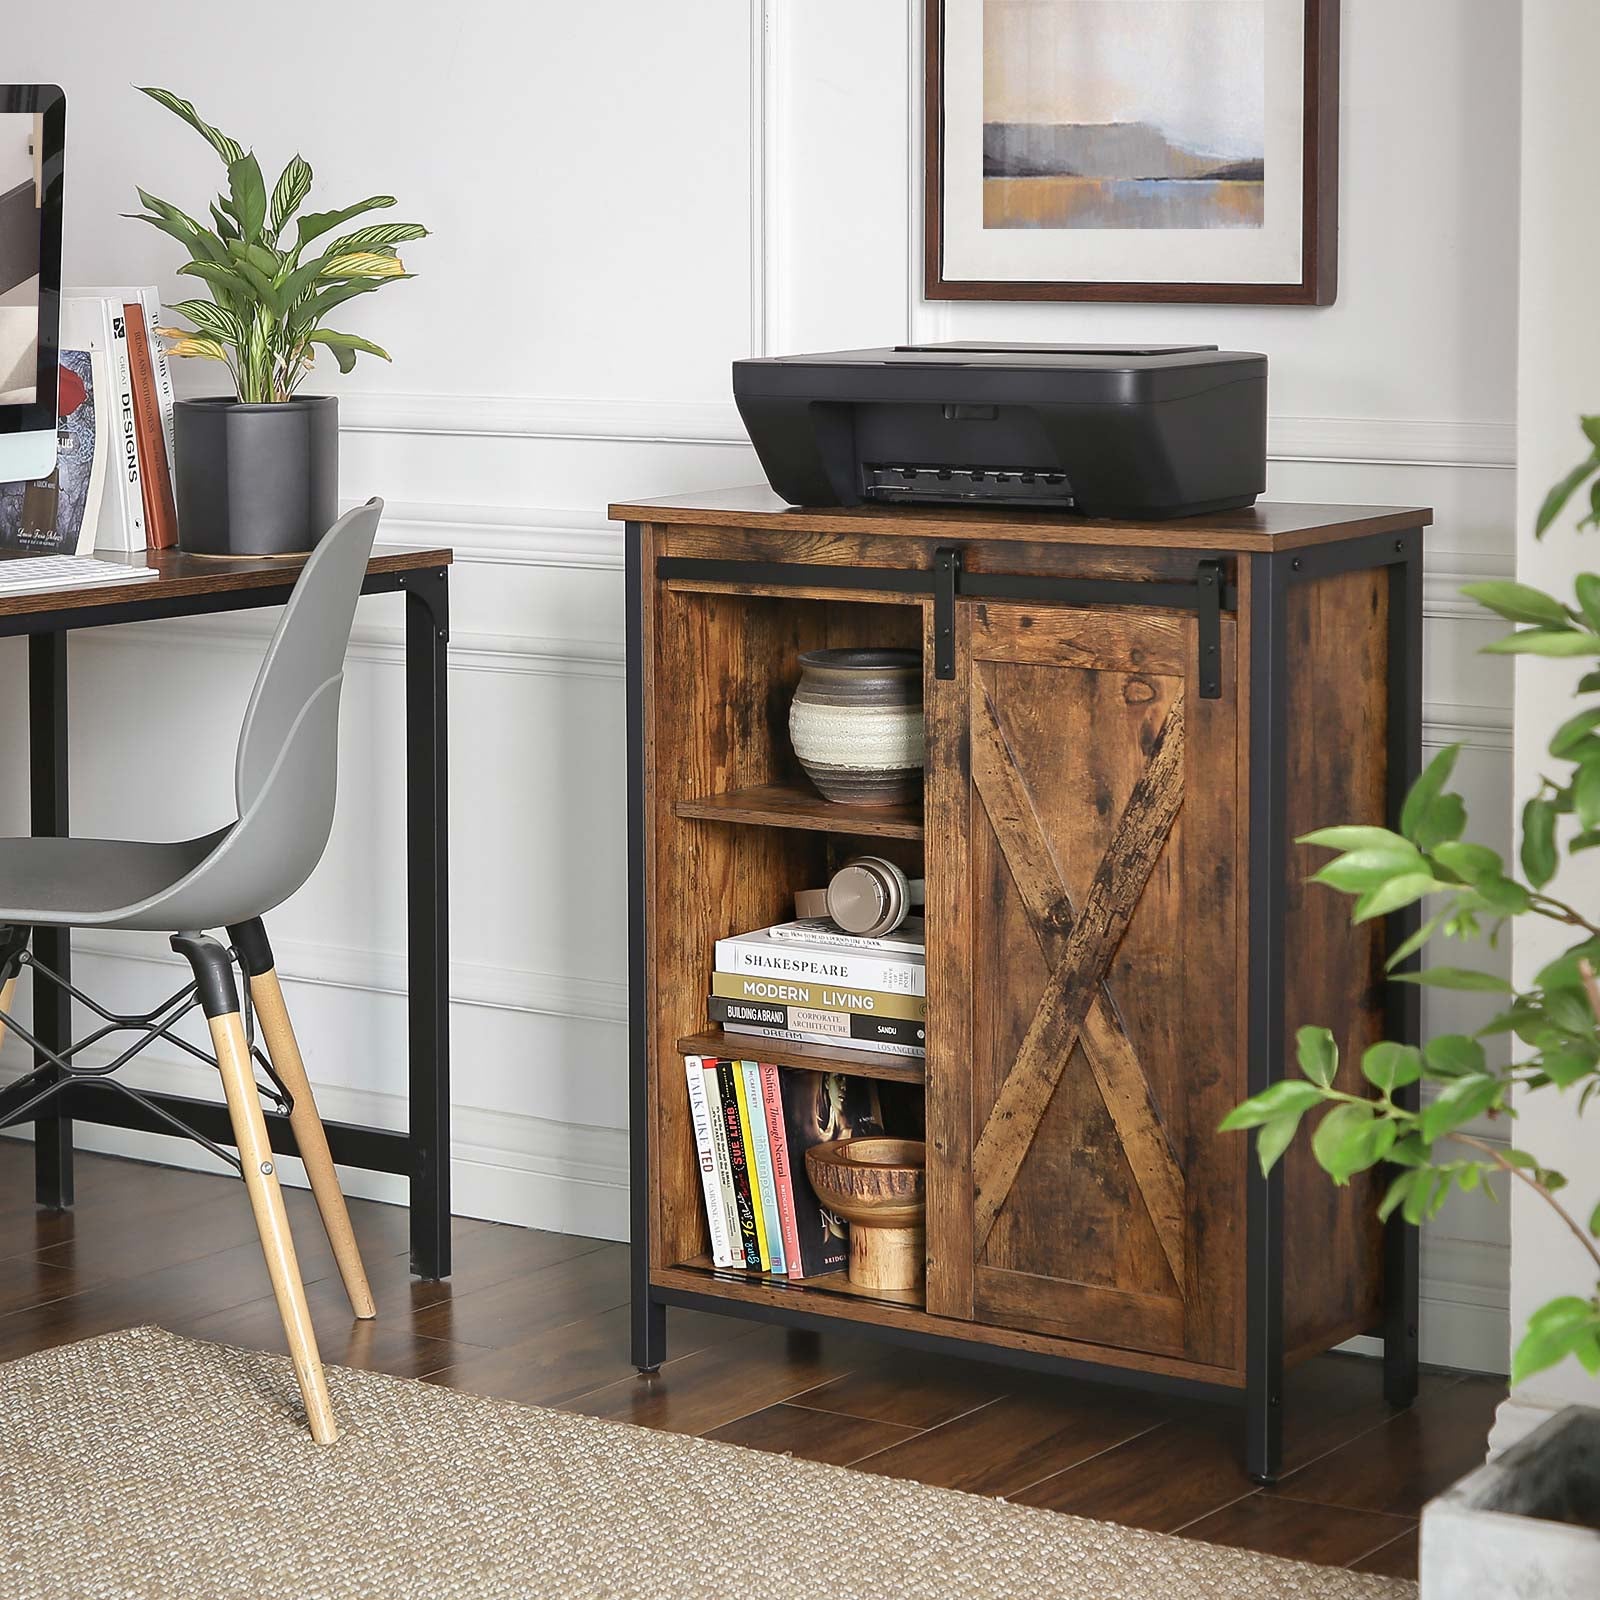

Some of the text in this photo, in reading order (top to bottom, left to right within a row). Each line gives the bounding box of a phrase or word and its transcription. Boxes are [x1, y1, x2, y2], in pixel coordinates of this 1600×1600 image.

[120, 355, 138, 483] GREAT DESIGNS
[744, 954, 849, 977] SHAKESPEARE
[743, 981, 874, 1010] MODERN LIVING
[727, 1005, 757, 1020] BUILDING
[762, 1009, 784, 1024] BRAND
[791, 1019, 848, 1033] ARCHITECTURE
[797, 1011, 841, 1024] CORPORATE
[762, 1028, 803, 1039] DREAM
[877, 1025, 897, 1035] SANDU
[690, 1074, 703, 1109] TALK
[696, 1114, 709, 1146] LIKE
[726, 1107, 739, 1137] LIMB
[764, 1067, 787, 1178] Shifting Through Neutral
[701, 1148, 714, 1172] TED
[731, 1141, 743, 1165] SUE
[755, 1135, 776, 1206] thumped
